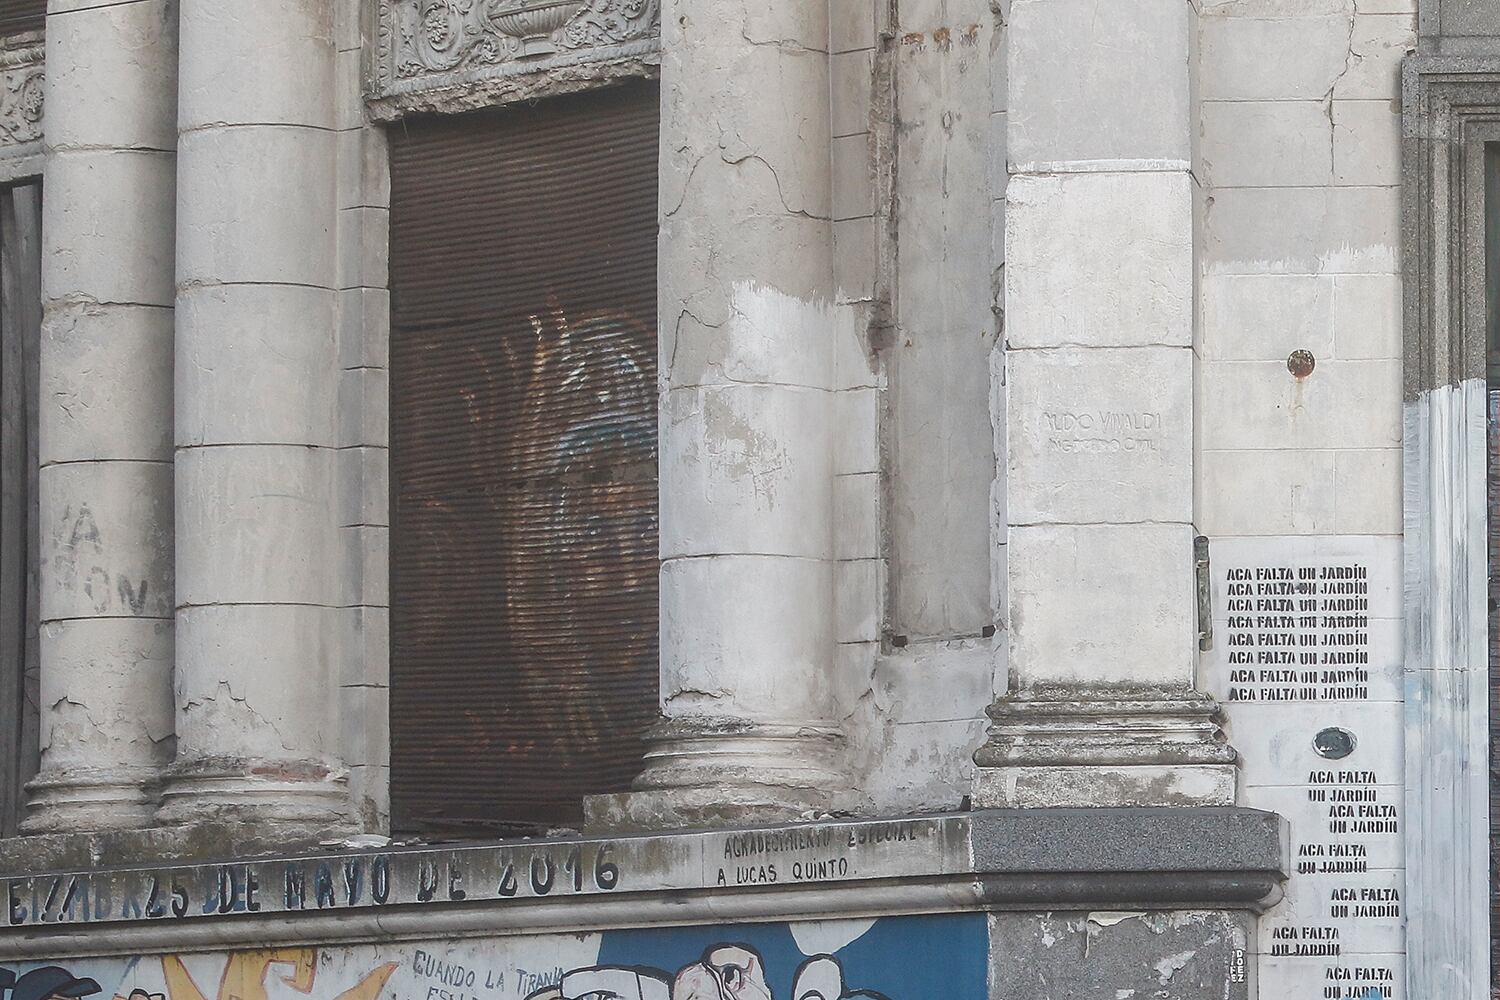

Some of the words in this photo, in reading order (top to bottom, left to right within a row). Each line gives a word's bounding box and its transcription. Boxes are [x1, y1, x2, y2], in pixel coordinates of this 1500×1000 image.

[1227, 569, 1252, 580] ACA
[1257, 568, 1293, 580] FALTA
[1299, 568, 1315, 579] UN
[1228, 600, 1252, 611] ACA
[1257, 599, 1294, 611] FALTA
[1300, 599, 1316, 611] UN
[1229, 634, 1254, 646] ACA
[1258, 634, 1295, 646] FALTA
[1300, 635, 1316, 646] UN
[1229, 652, 1253, 663] ACA
[1258, 652, 1295, 664] FALTA
[1300, 653, 1317, 664] UN
[1230, 670, 1255, 682] ACA
[1260, 670, 1297, 682] FALTA
[1301, 672, 1317, 683] UN
[1229, 688, 1255, 701] ACA
[1261, 688, 1296, 700] FALTA
[1300, 688, 1316, 700] UN
[1309, 771, 1334, 783] ACA
[1339, 772, 1376, 783] FALTA
[1309, 790, 1325, 801] UN
[1330, 805, 1354, 817] ACA
[1359, 805, 1396, 817] FALTA
[1330, 820, 1346, 833] UN
[1329, 845, 1366, 856] FALTA
[218, 864, 262, 913] DE
[284, 853, 391, 910] MAYO
[498, 842, 620, 897] 2016
[718, 868, 727, 886] A
[737, 865, 777, 885] LUCAS
[1331, 889, 1356, 900] ACA
[1361, 889, 1399, 901] FALTA
[1331, 905, 1348, 917] UN
[413, 950, 475, 988] CUANDO
[485, 970, 505, 992] LA
